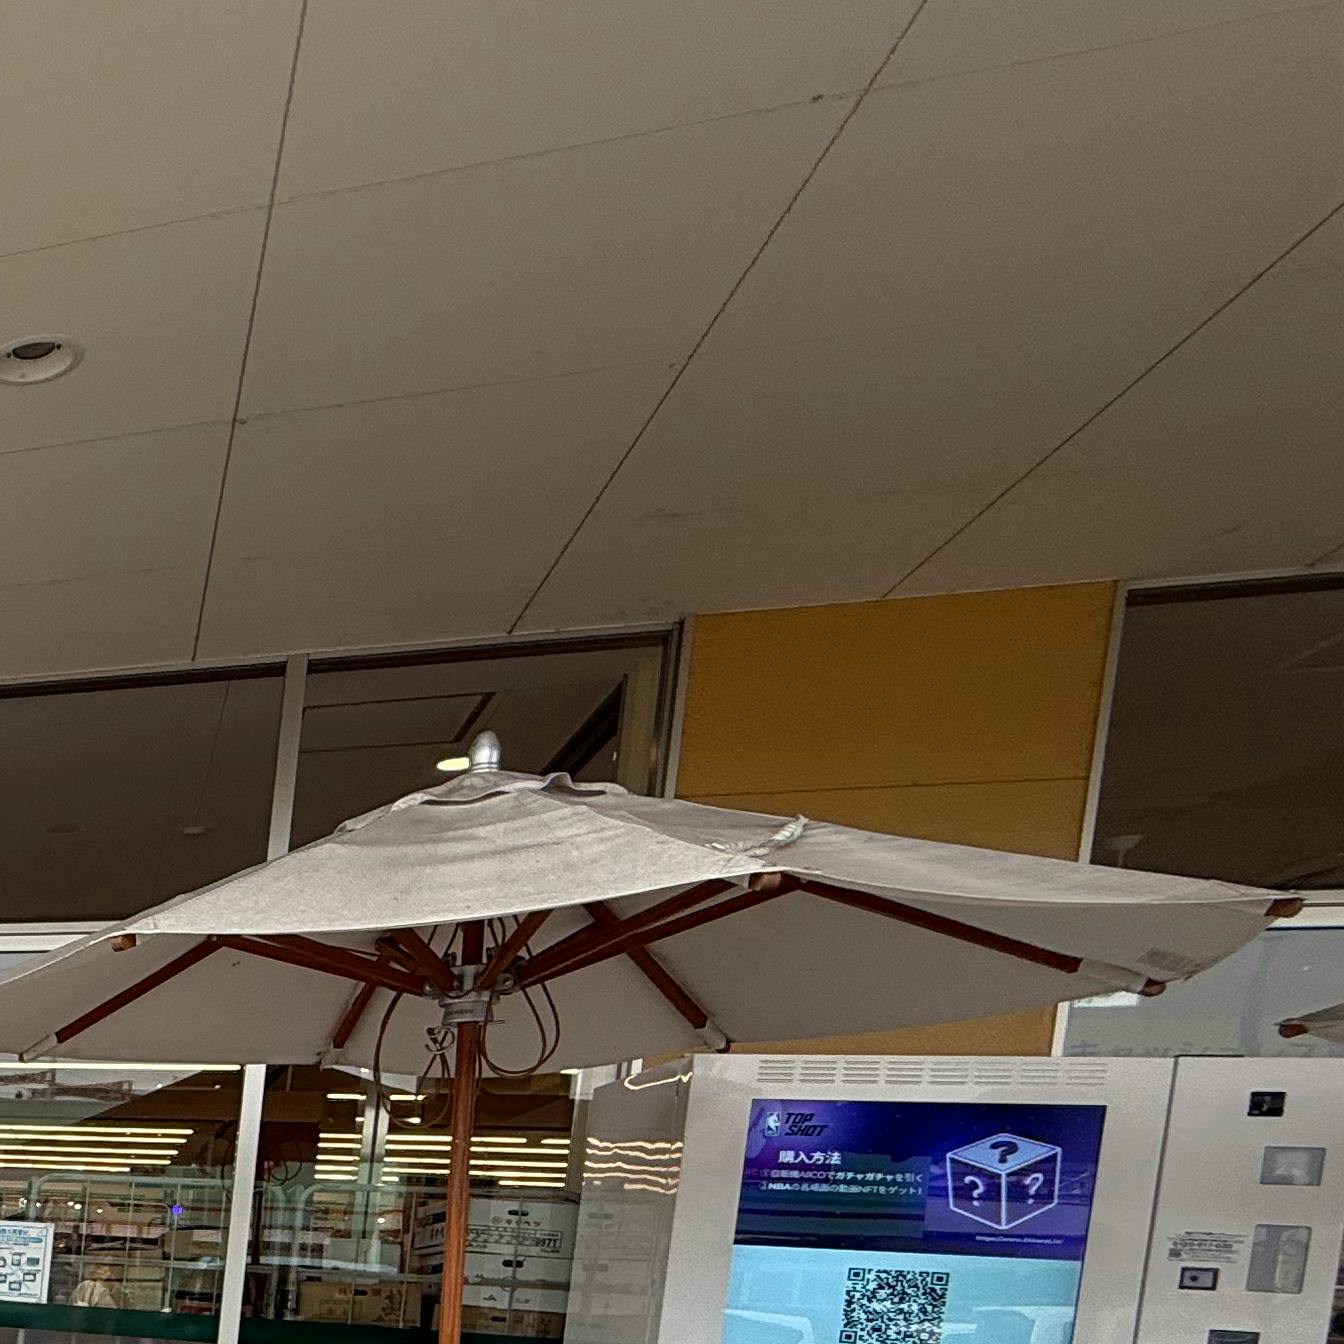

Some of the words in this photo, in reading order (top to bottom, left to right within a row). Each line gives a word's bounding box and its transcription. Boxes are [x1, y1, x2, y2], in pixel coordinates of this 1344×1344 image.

[785, 1112, 815, 1125] TOP
[784, 1124, 828, 1137] SHOT
[777, 1150, 842, 1165] 購入方法
